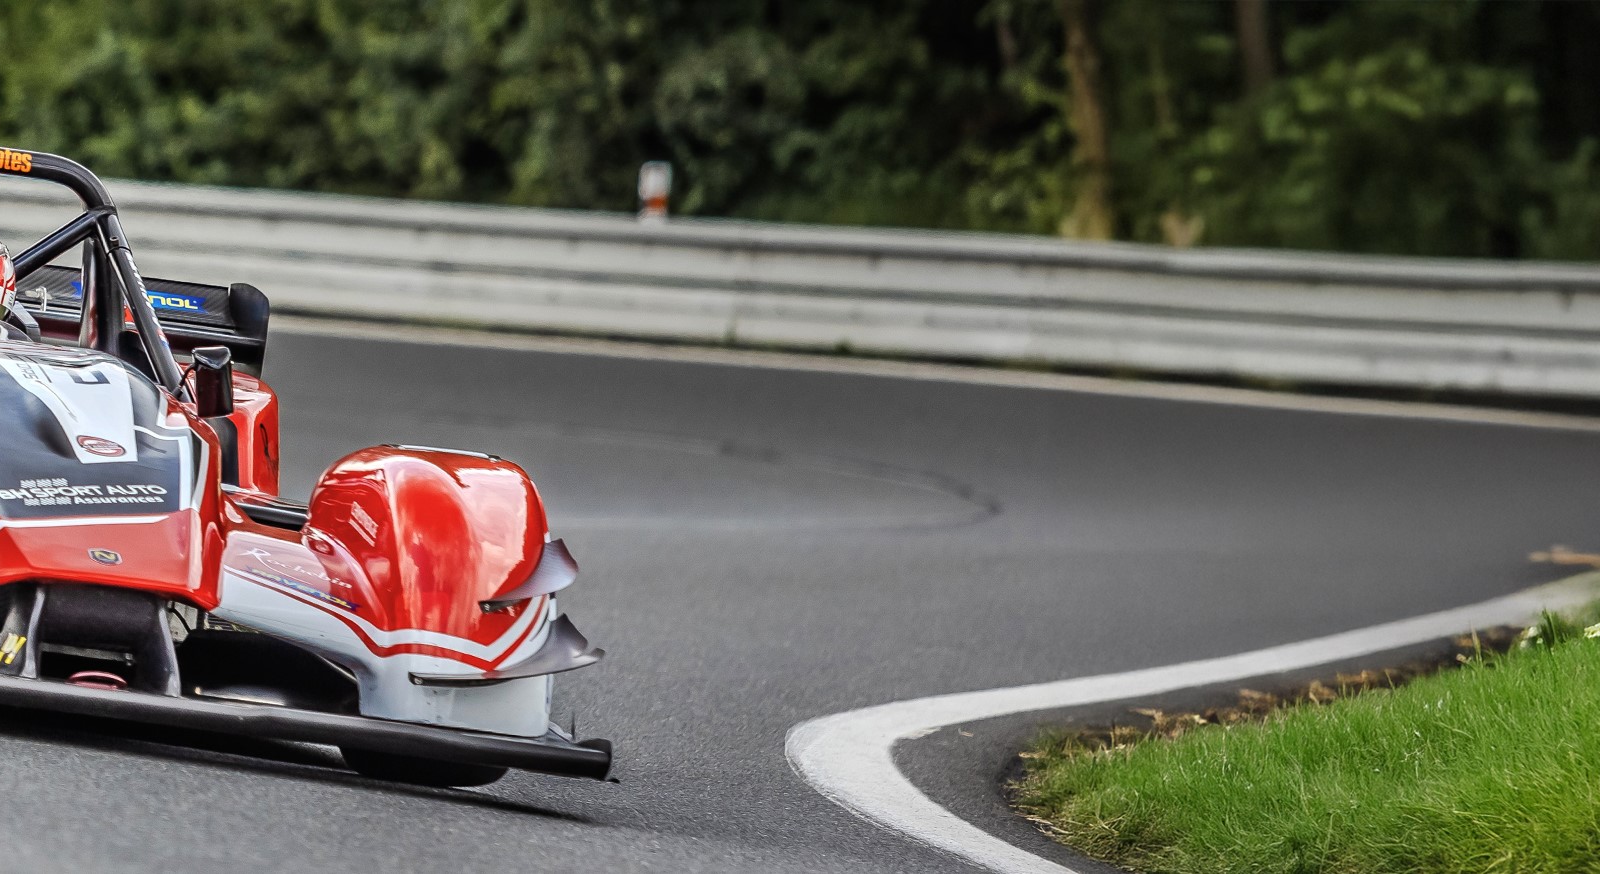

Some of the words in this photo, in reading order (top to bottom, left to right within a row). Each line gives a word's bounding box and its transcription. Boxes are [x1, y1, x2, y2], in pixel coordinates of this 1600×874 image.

[29, 485, 106, 498] SPORT
[106, 484, 168, 496] AUTO
[74, 495, 164, 505] Assurances
